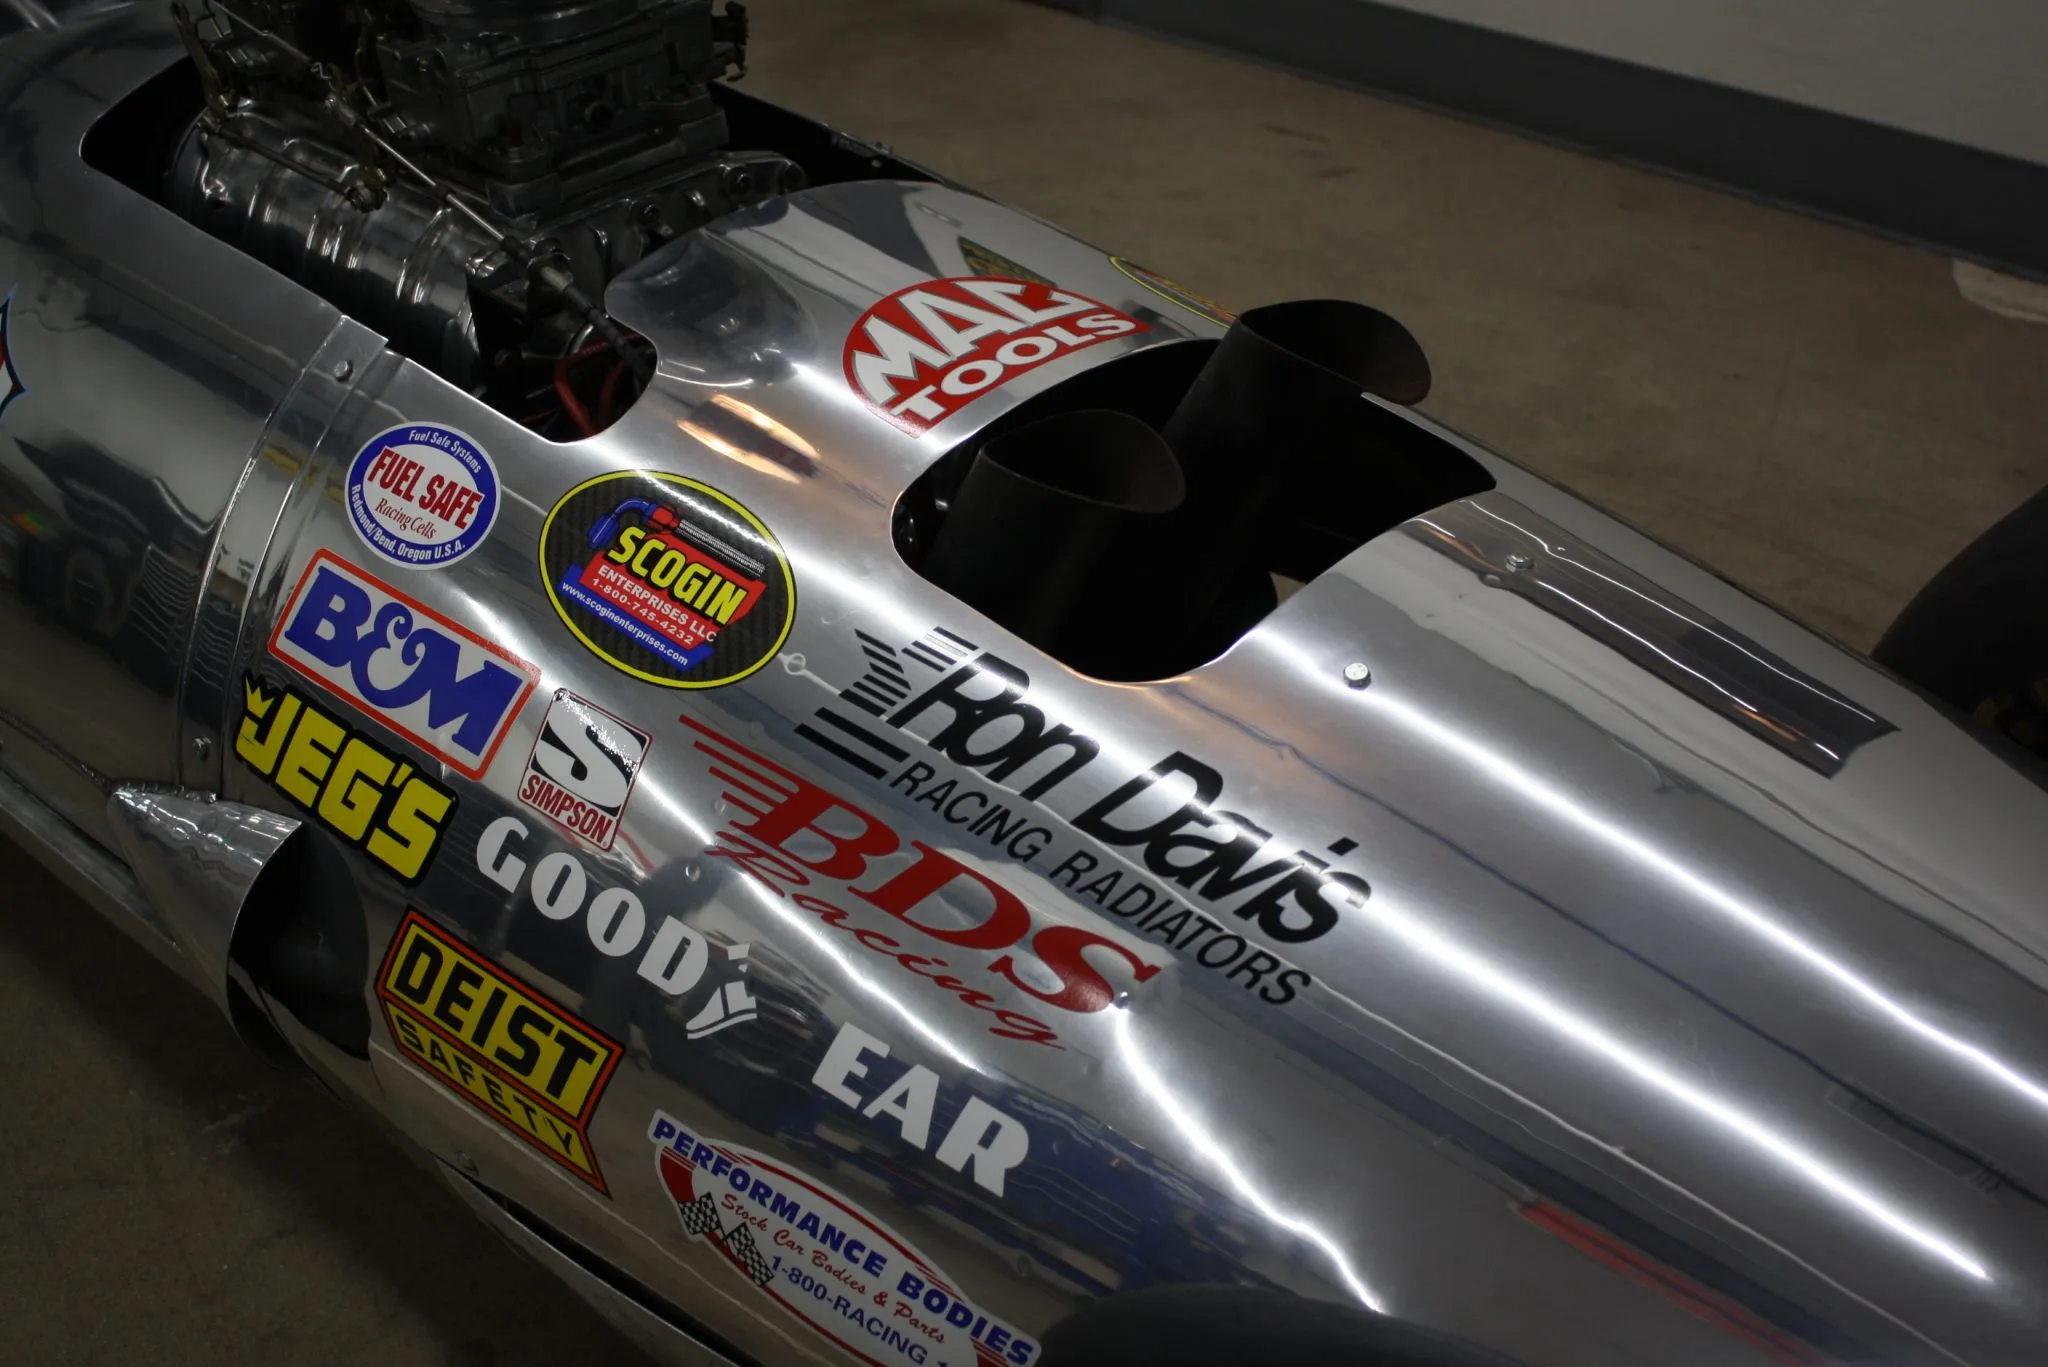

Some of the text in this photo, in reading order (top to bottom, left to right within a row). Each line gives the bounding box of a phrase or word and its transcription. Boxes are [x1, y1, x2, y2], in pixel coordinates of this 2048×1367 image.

[853, 279, 1101, 405] MAC
[889, 313, 1137, 422] TOOLS
[367, 448, 484, 530] FUEL SAFE
[409, 429, 482, 473] Fuel Safe Systems
[352, 484, 466, 562] Redmond/Bend, Oregon U.S.A.
[375, 498, 437, 540] Racing Cells
[607, 526, 748, 625] SCOGIN
[284, 565, 523, 757] B&M
[562, 582, 689, 667] www.scoginenterprises.com
[592, 578, 694, 645] 1-800-745-4232
[598, 564, 718, 643] ENTERPRISES LLC
[235, 690, 453, 880] JEG'S
[521, 773, 612, 844] SIMPSON
[885, 652, 1372, 944] Ron Davis
[703, 830, 1066, 1051] Racing
[728, 783, 1162, 1014] BDS
[891, 760, 1312, 1005] RACING RADIATORS
[394, 933, 598, 1100] DEIST
[396, 1014, 573, 1156] SAFETY
[653, 1118, 1034, 1366] PERFORMANCE BODIES
[721, 1193, 946, 1344] Stock Car Bodies & Parts
[771, 1255, 929, 1365] 1-800-RACING
